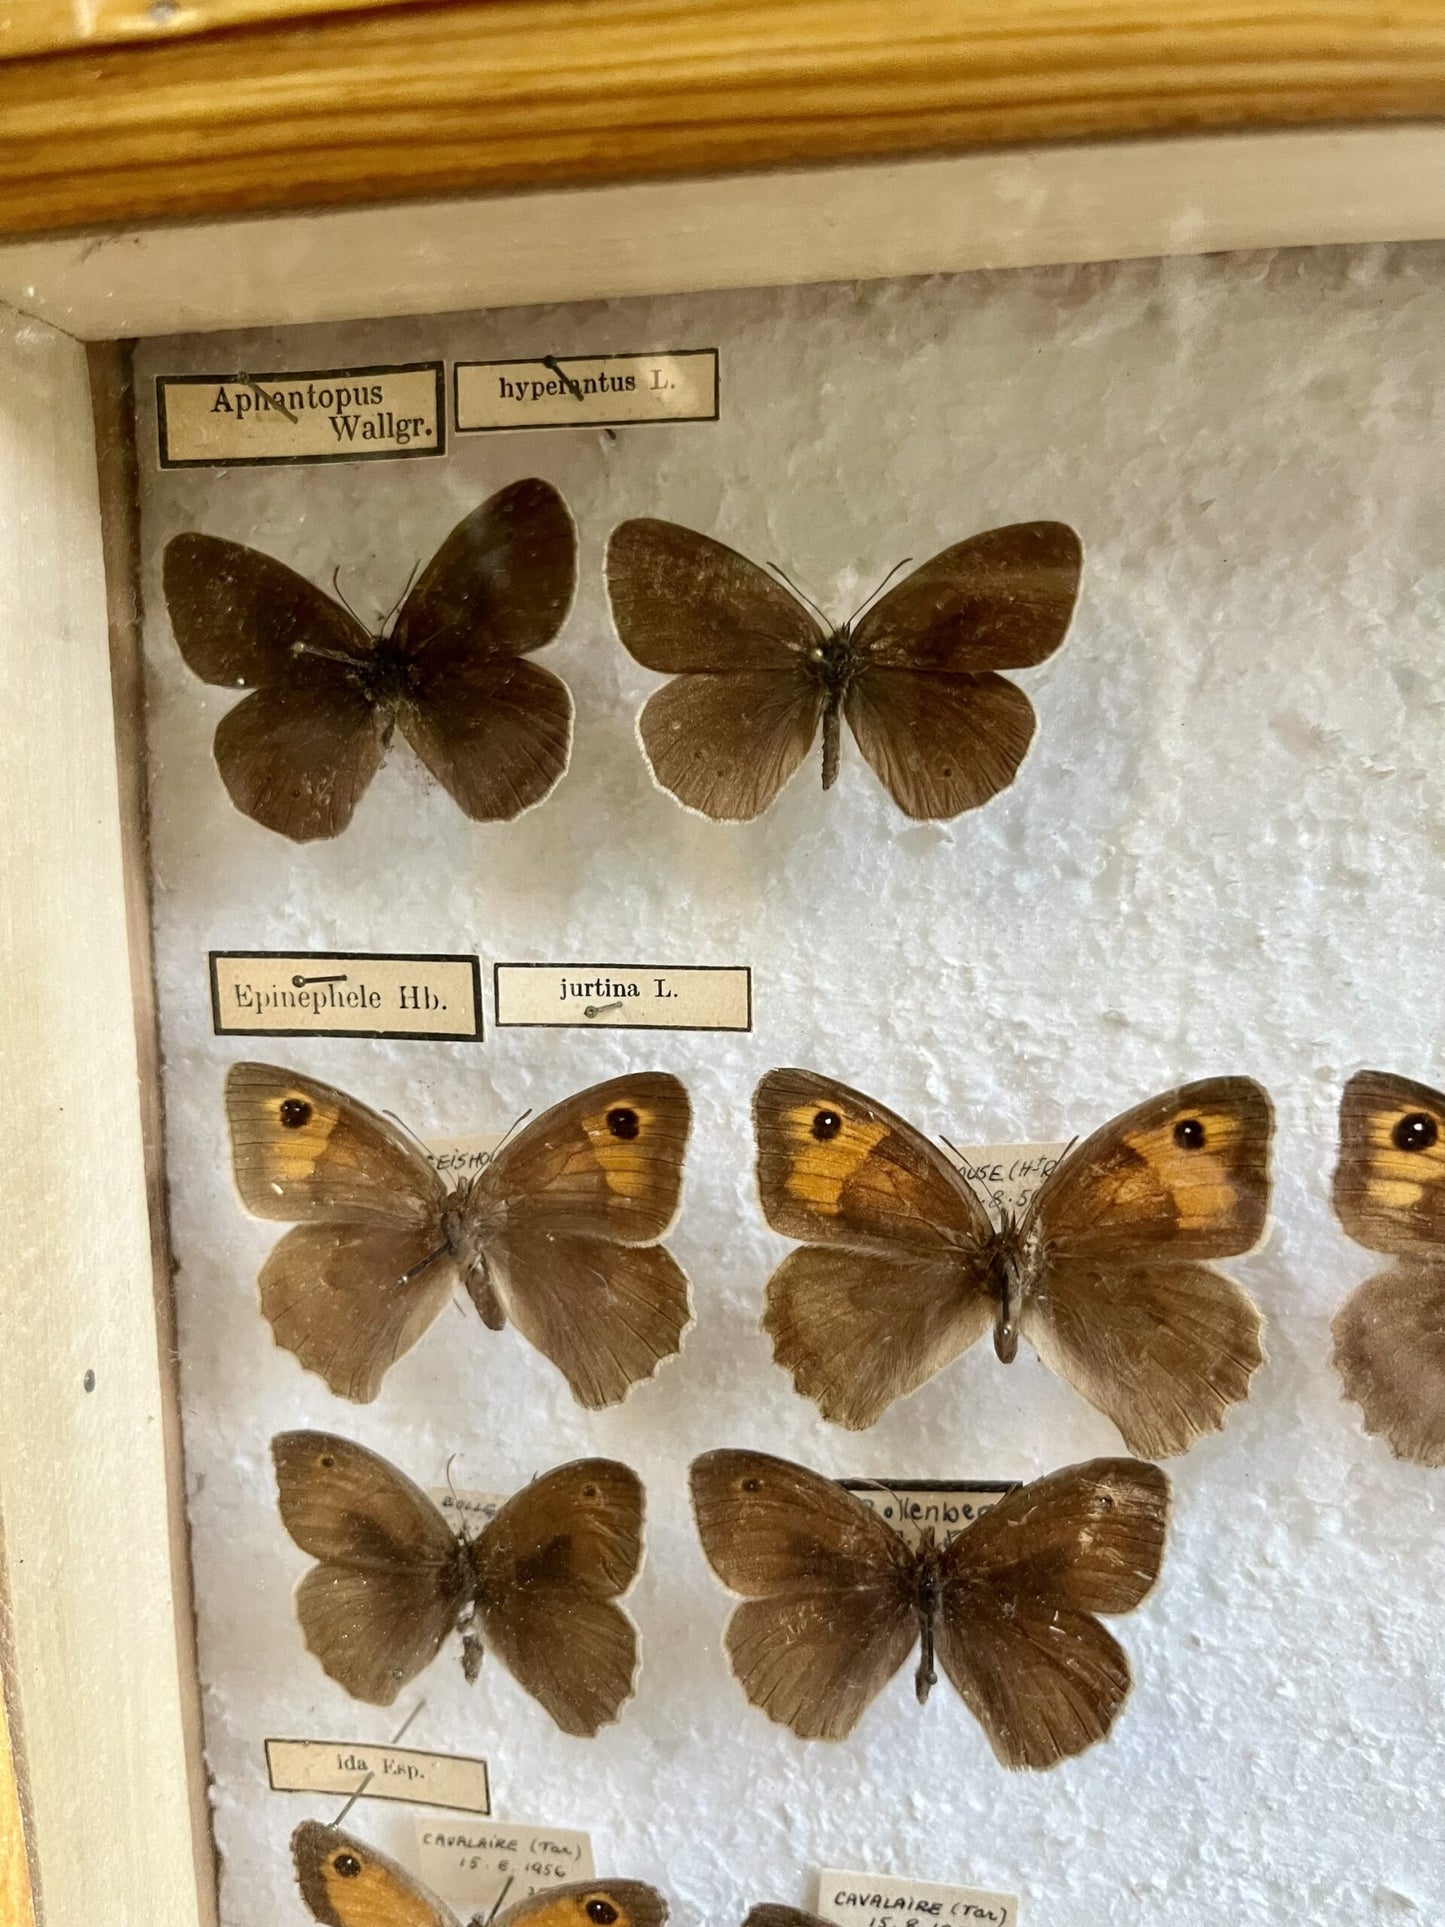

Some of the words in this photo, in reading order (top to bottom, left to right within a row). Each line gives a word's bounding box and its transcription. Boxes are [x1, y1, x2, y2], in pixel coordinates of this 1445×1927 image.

[499, 371, 636, 401] hyperantus
[650, 369, 676, 391] L.
[211, 384, 383, 420] Aphantopus
[328, 411, 433, 444] Wallgr.
[234, 983, 382, 1015] Epinephele
[399, 985, 448, 1011] Hb.
[560, 978, 640, 1001] jurtina
[654, 978, 679, 998] L.
[336, 1753, 369, 1771] ida
[383, 1758, 426, 1780] Esp.
